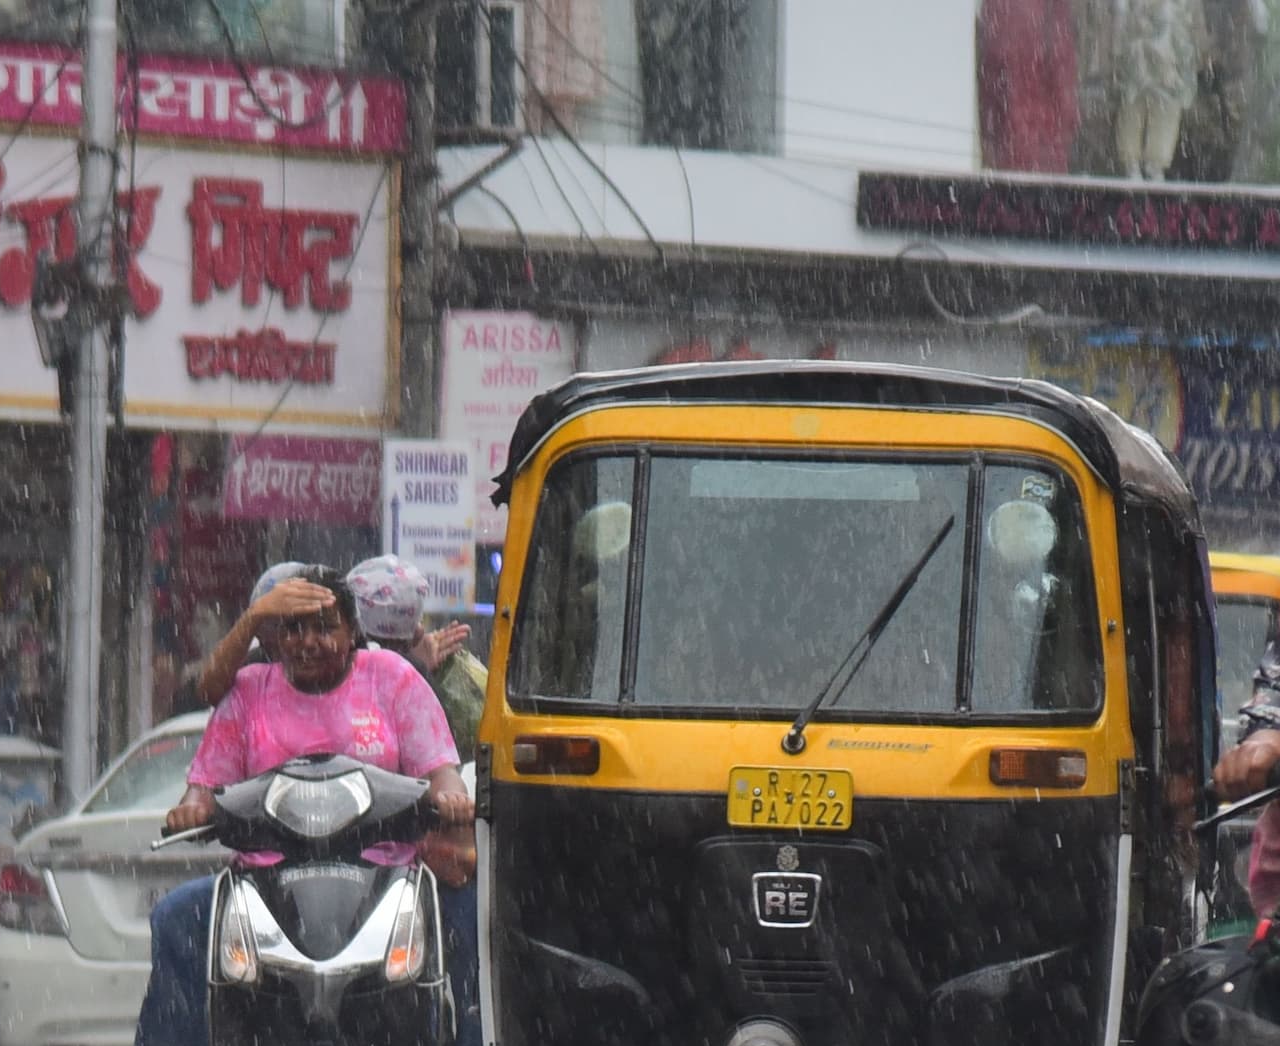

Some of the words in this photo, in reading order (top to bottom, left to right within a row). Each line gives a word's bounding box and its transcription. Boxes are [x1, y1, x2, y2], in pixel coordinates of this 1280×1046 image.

[462, 324, 562, 352] ARISSA
[395, 451, 469, 476] SHRINGAR
[405, 481, 459, 505] SAREES
[765, 891, 808, 916] RE
